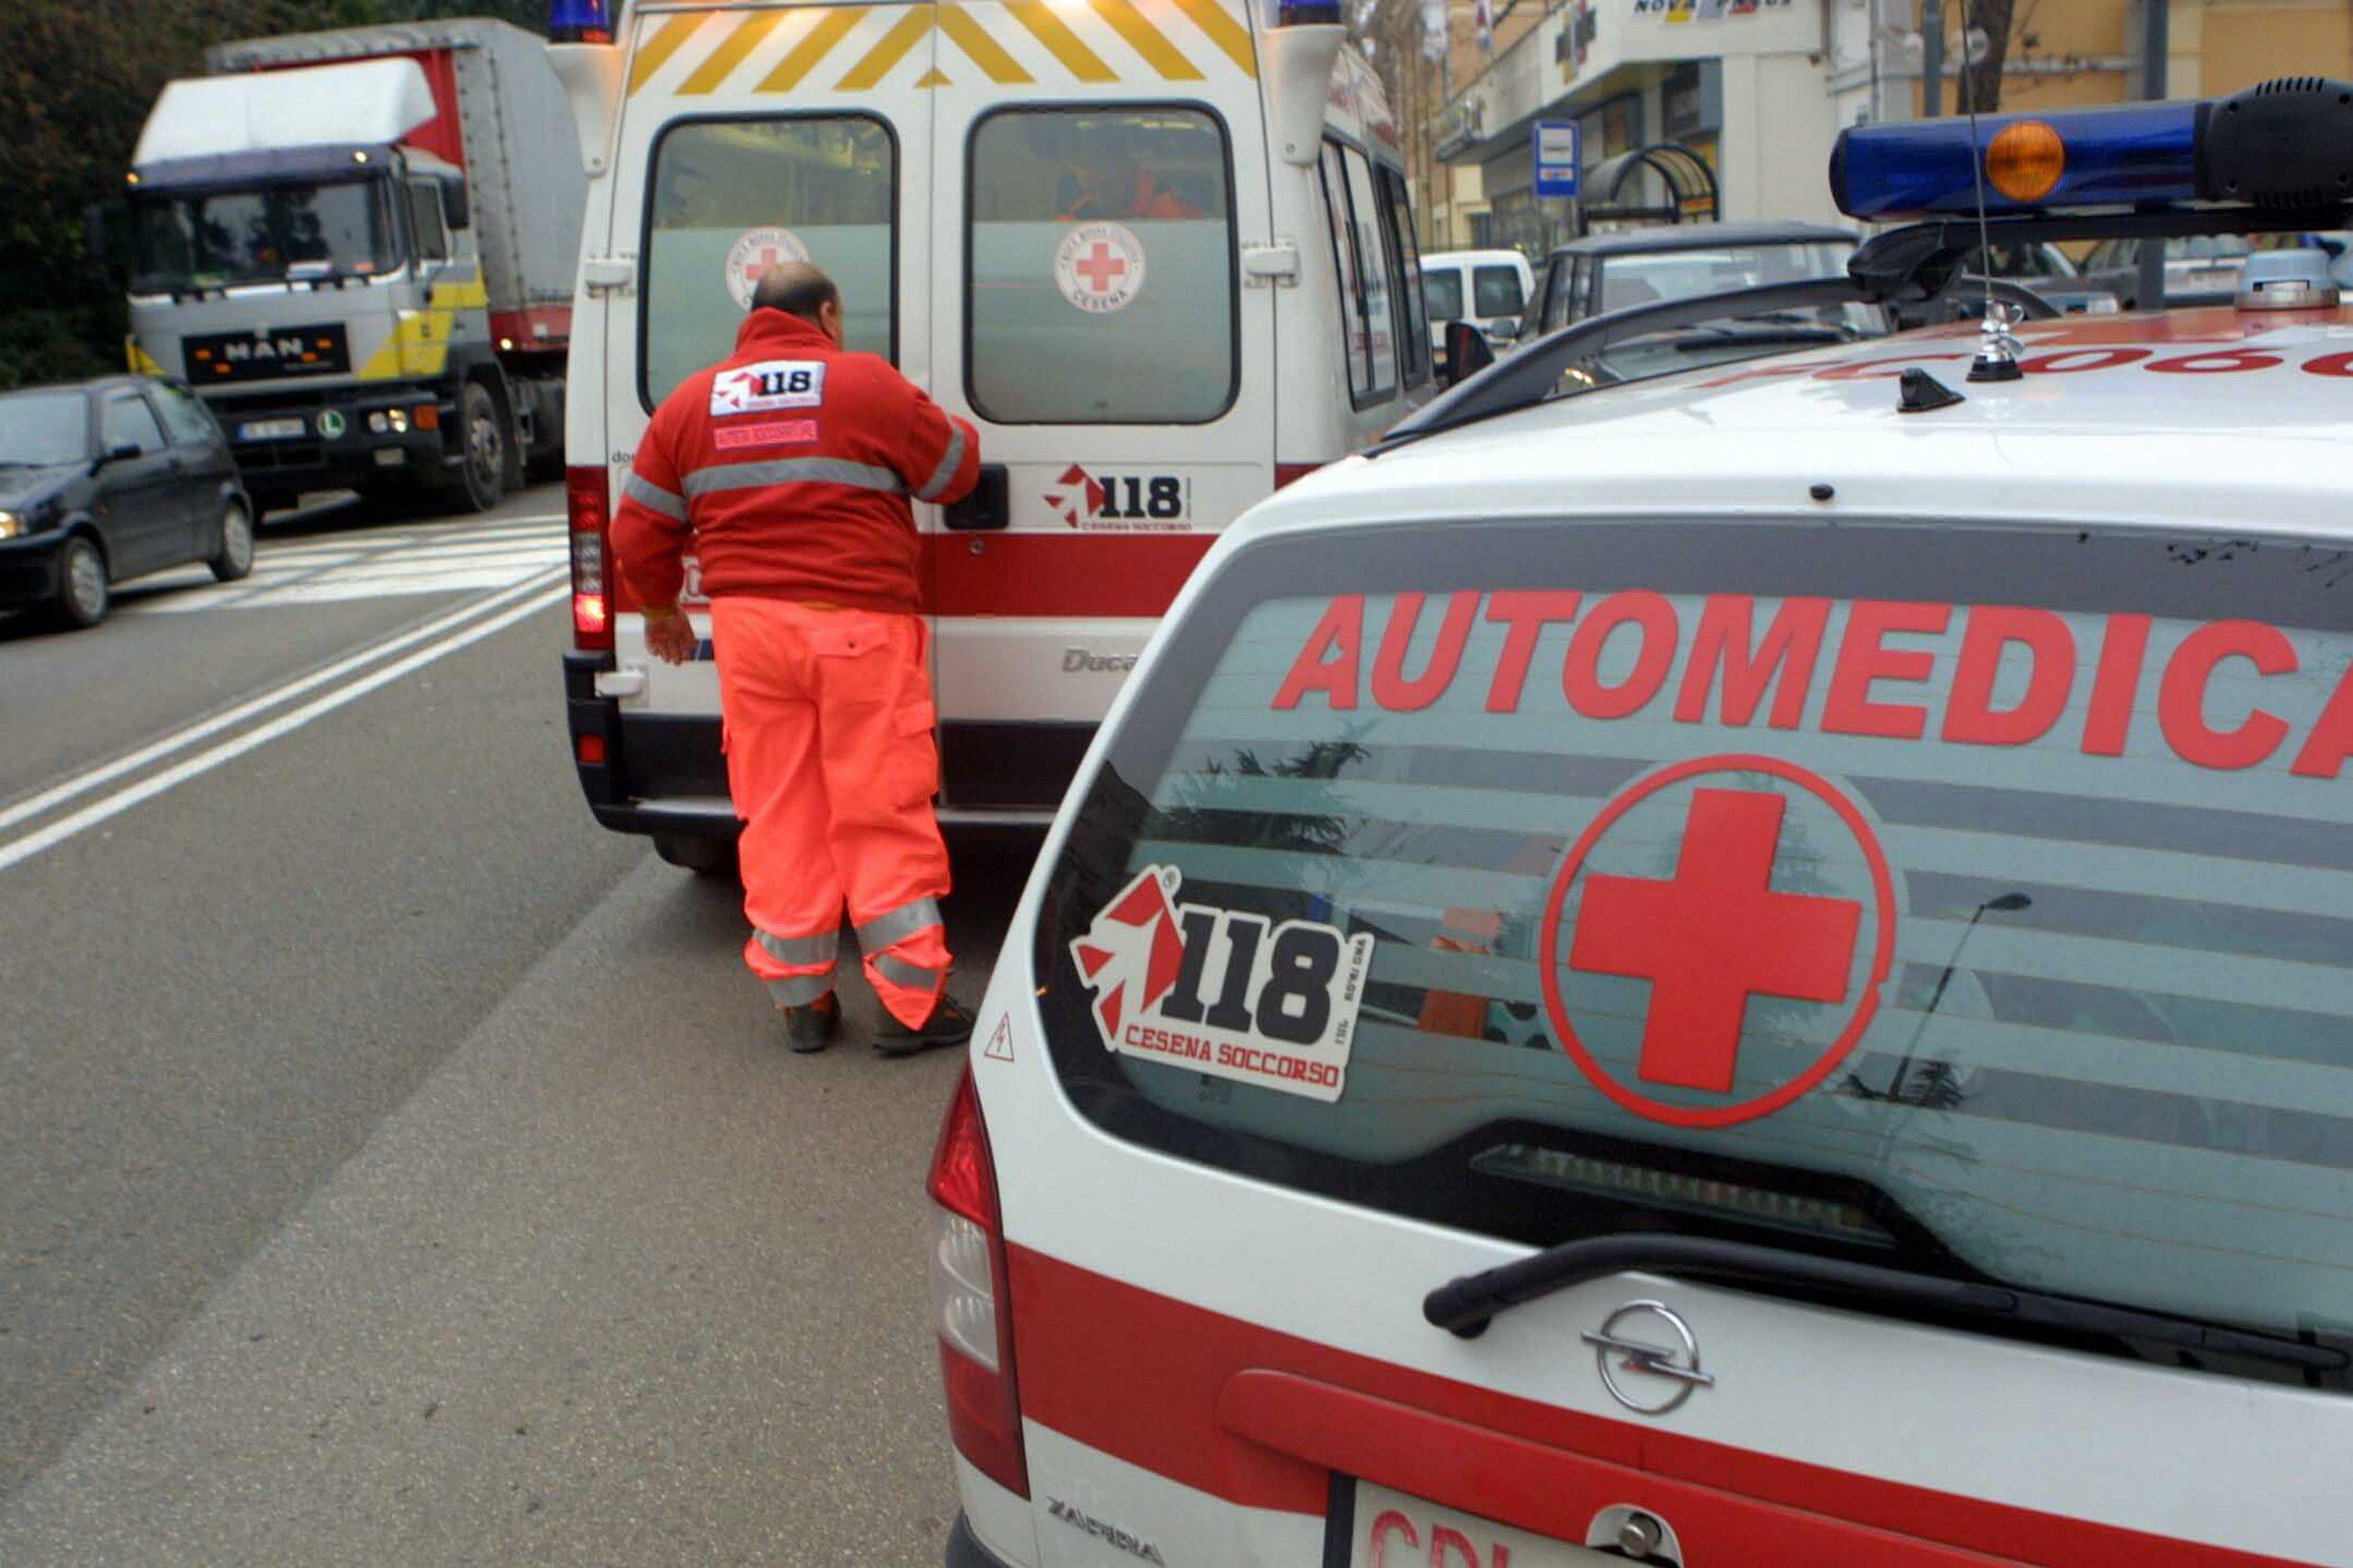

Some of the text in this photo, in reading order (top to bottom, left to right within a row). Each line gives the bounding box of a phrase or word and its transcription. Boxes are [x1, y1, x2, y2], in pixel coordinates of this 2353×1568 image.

[223, 337, 303, 361] MAN
[756, 370, 812, 397] 118
[1099, 477, 1181, 518] 118
[1159, 911, 1341, 1046] 118
[1124, 1024, 1341, 1088] CESENA SOCCORSO
